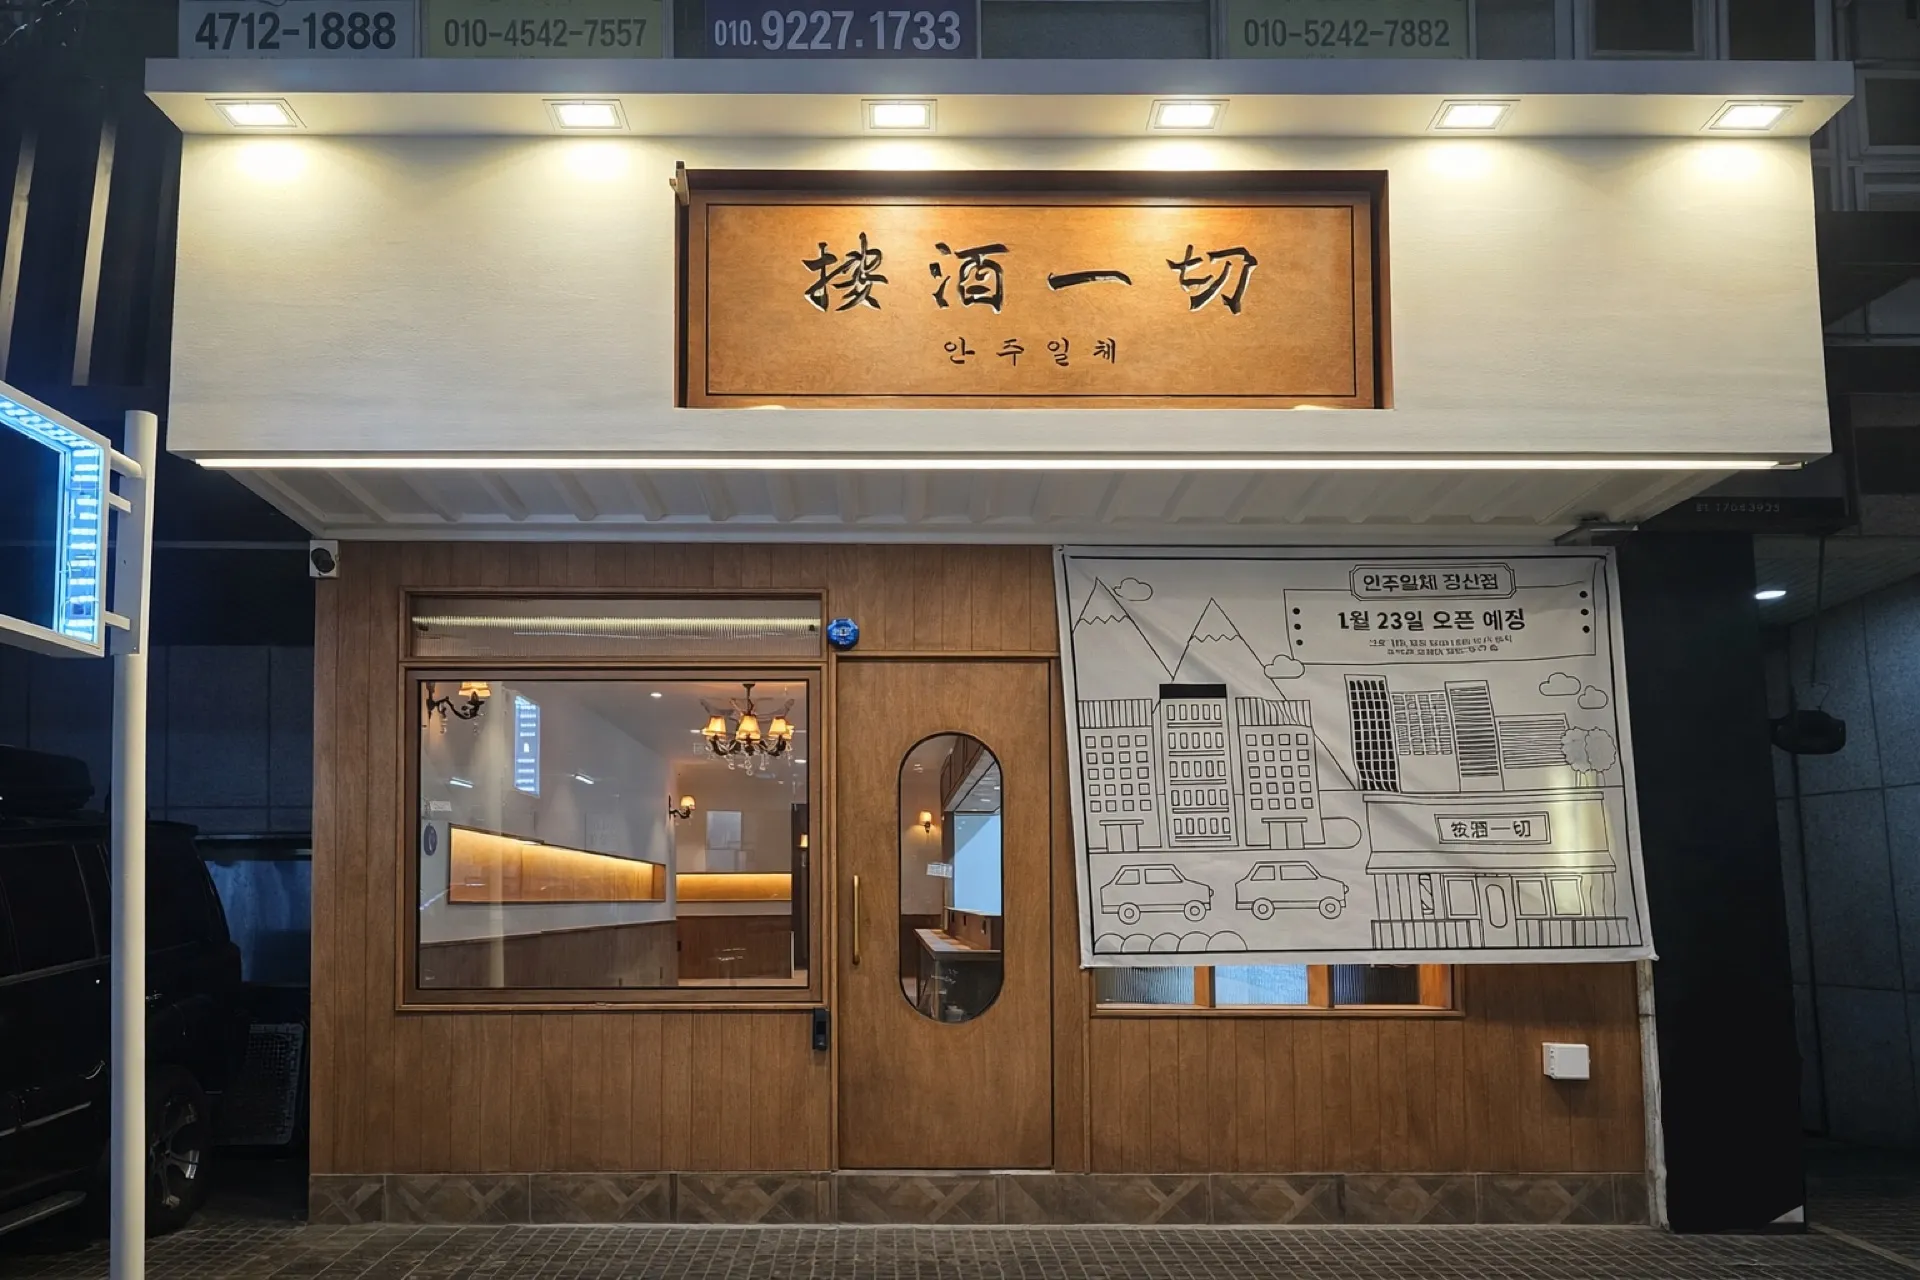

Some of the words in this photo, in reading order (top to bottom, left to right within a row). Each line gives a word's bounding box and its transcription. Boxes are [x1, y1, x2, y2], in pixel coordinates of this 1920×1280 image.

[194, 12, 397, 50] 4712-1888
[445, 18, 646, 48] 010-4542-7557
[1244, 19, 1450, 47] 010-5242-7882
[1338, 611, 1370, 631] 1월
[1377, 611, 1424, 630] 23일
[1433, 611, 1475, 630] 오픈
[1483, 608, 1526, 631] 예정
